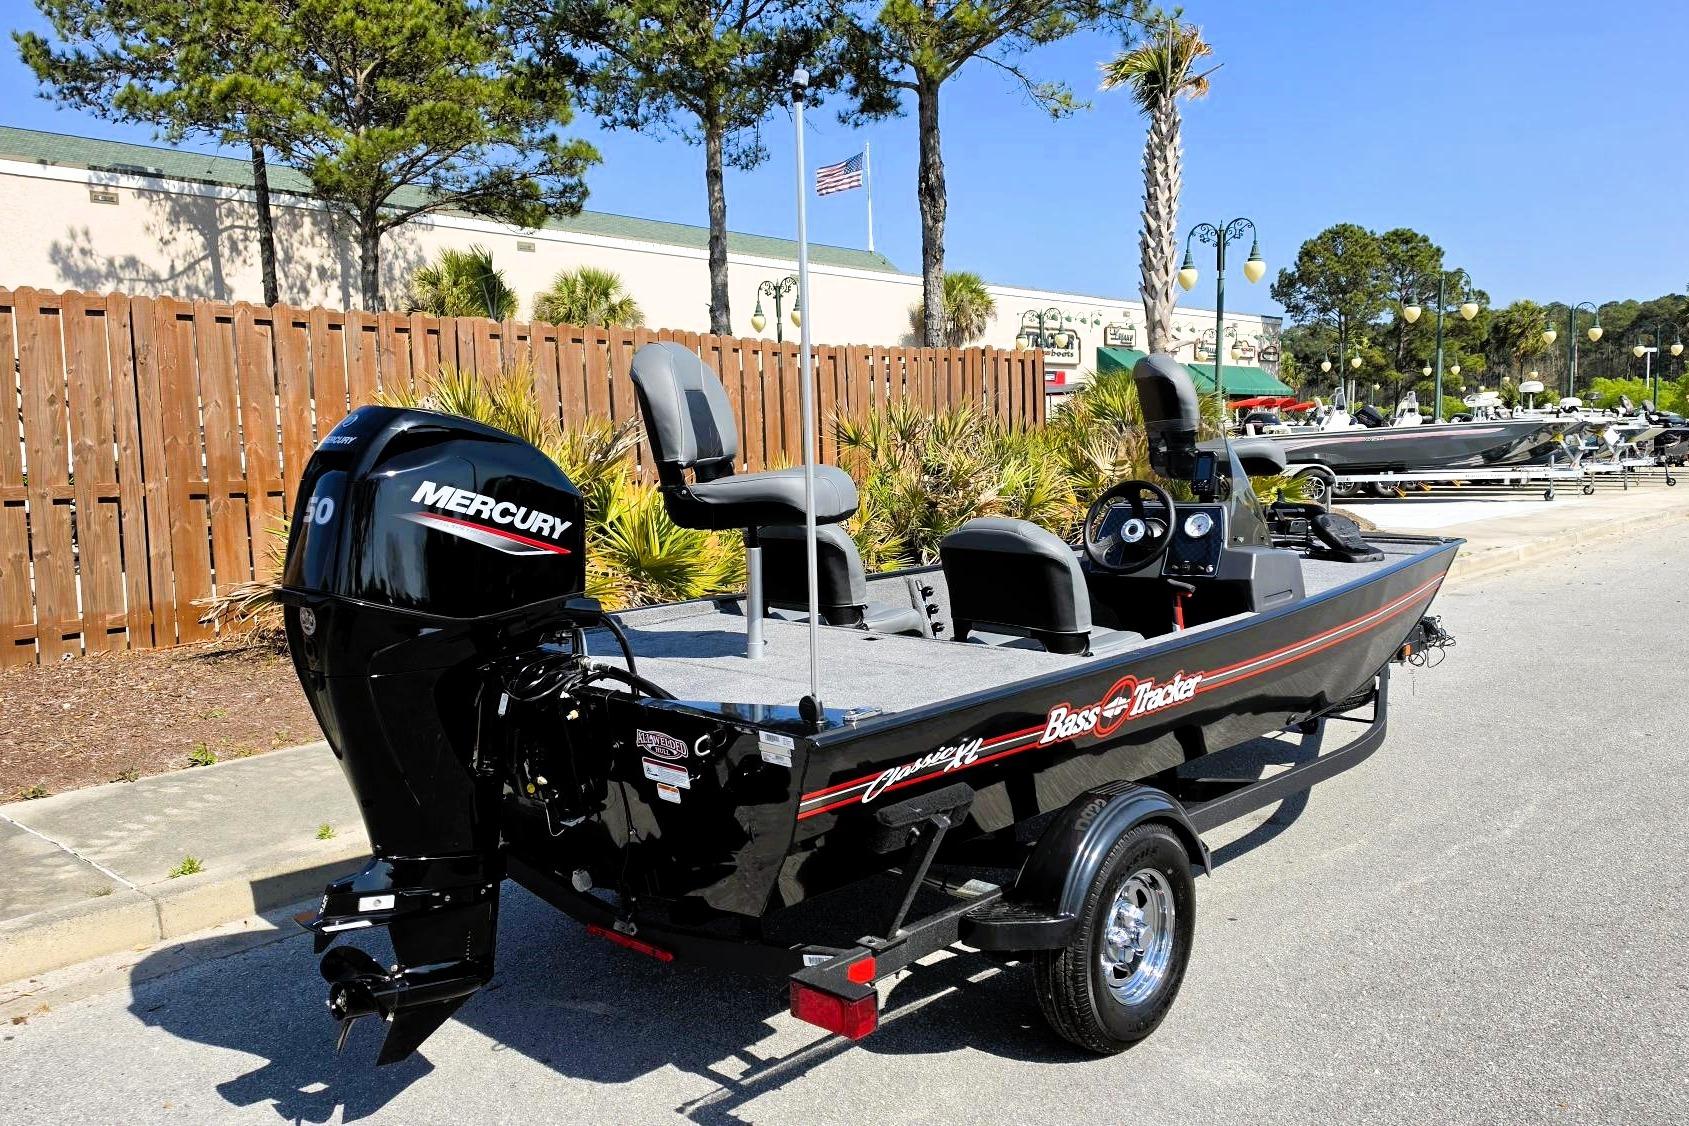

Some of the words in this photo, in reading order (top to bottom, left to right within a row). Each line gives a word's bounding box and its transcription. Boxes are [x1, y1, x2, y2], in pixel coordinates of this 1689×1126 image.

[303, 496, 334, 525] 50
[411, 480, 573, 540] MERCURY
[1039, 707, 1102, 745] Bass
[1130, 673, 1204, 717] Tracker
[639, 731, 653, 744] ALL
[652, 734, 687, 755] WELDED
[861, 745, 956, 804] Classic
[943, 737, 984, 773] XL
